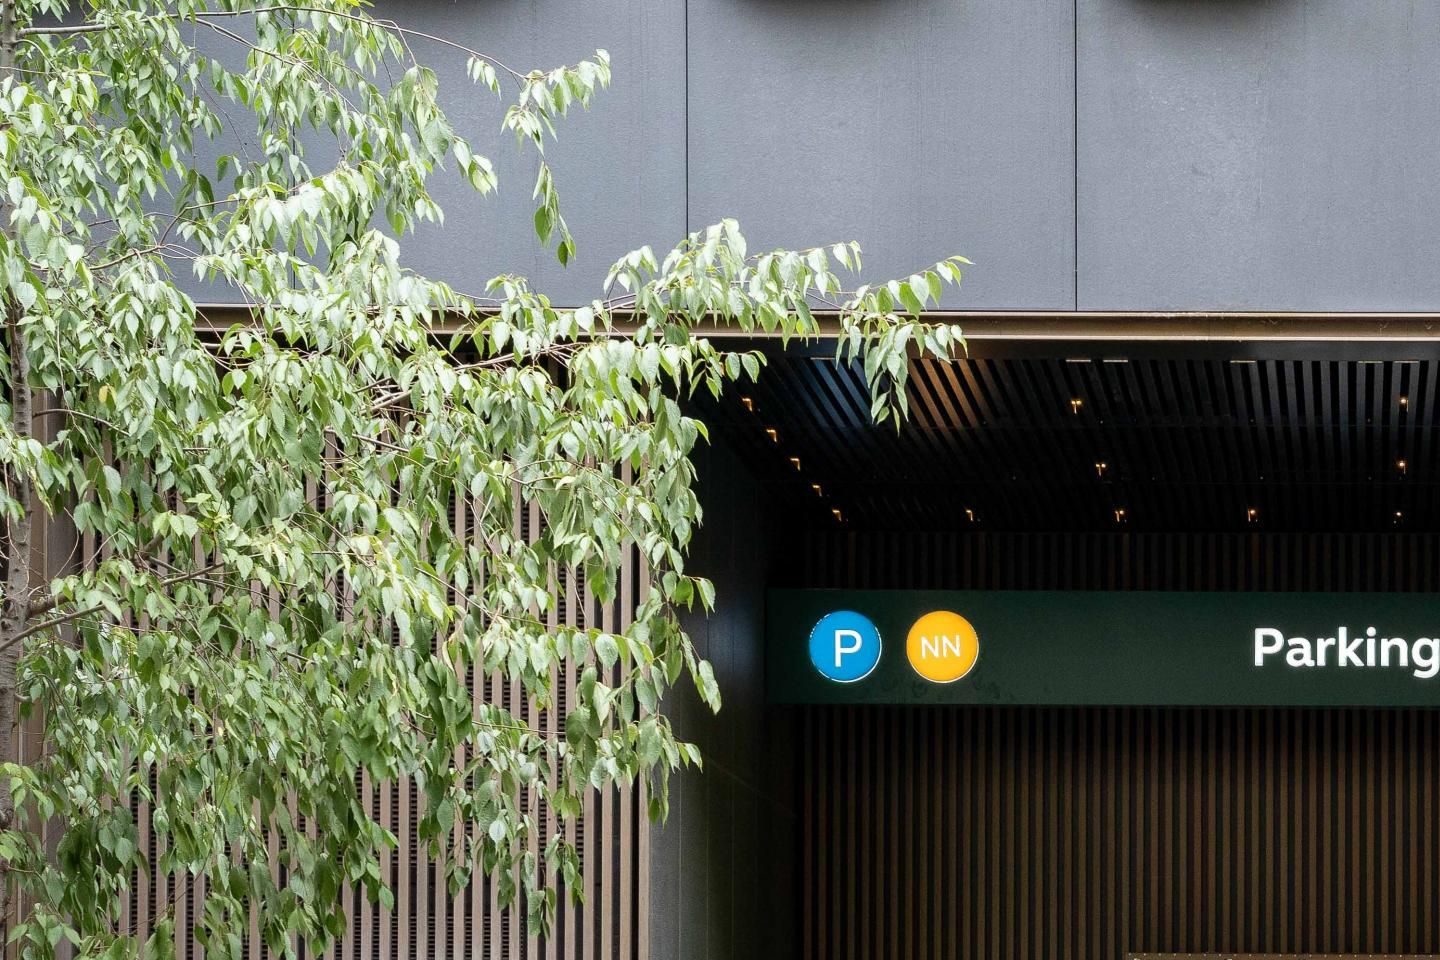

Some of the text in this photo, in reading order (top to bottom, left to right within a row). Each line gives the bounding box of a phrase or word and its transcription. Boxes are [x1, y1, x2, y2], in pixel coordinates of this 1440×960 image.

[834, 629, 863, 668] P
[920, 634, 961, 659] NN
[1254, 626, 1440, 679] Parking
